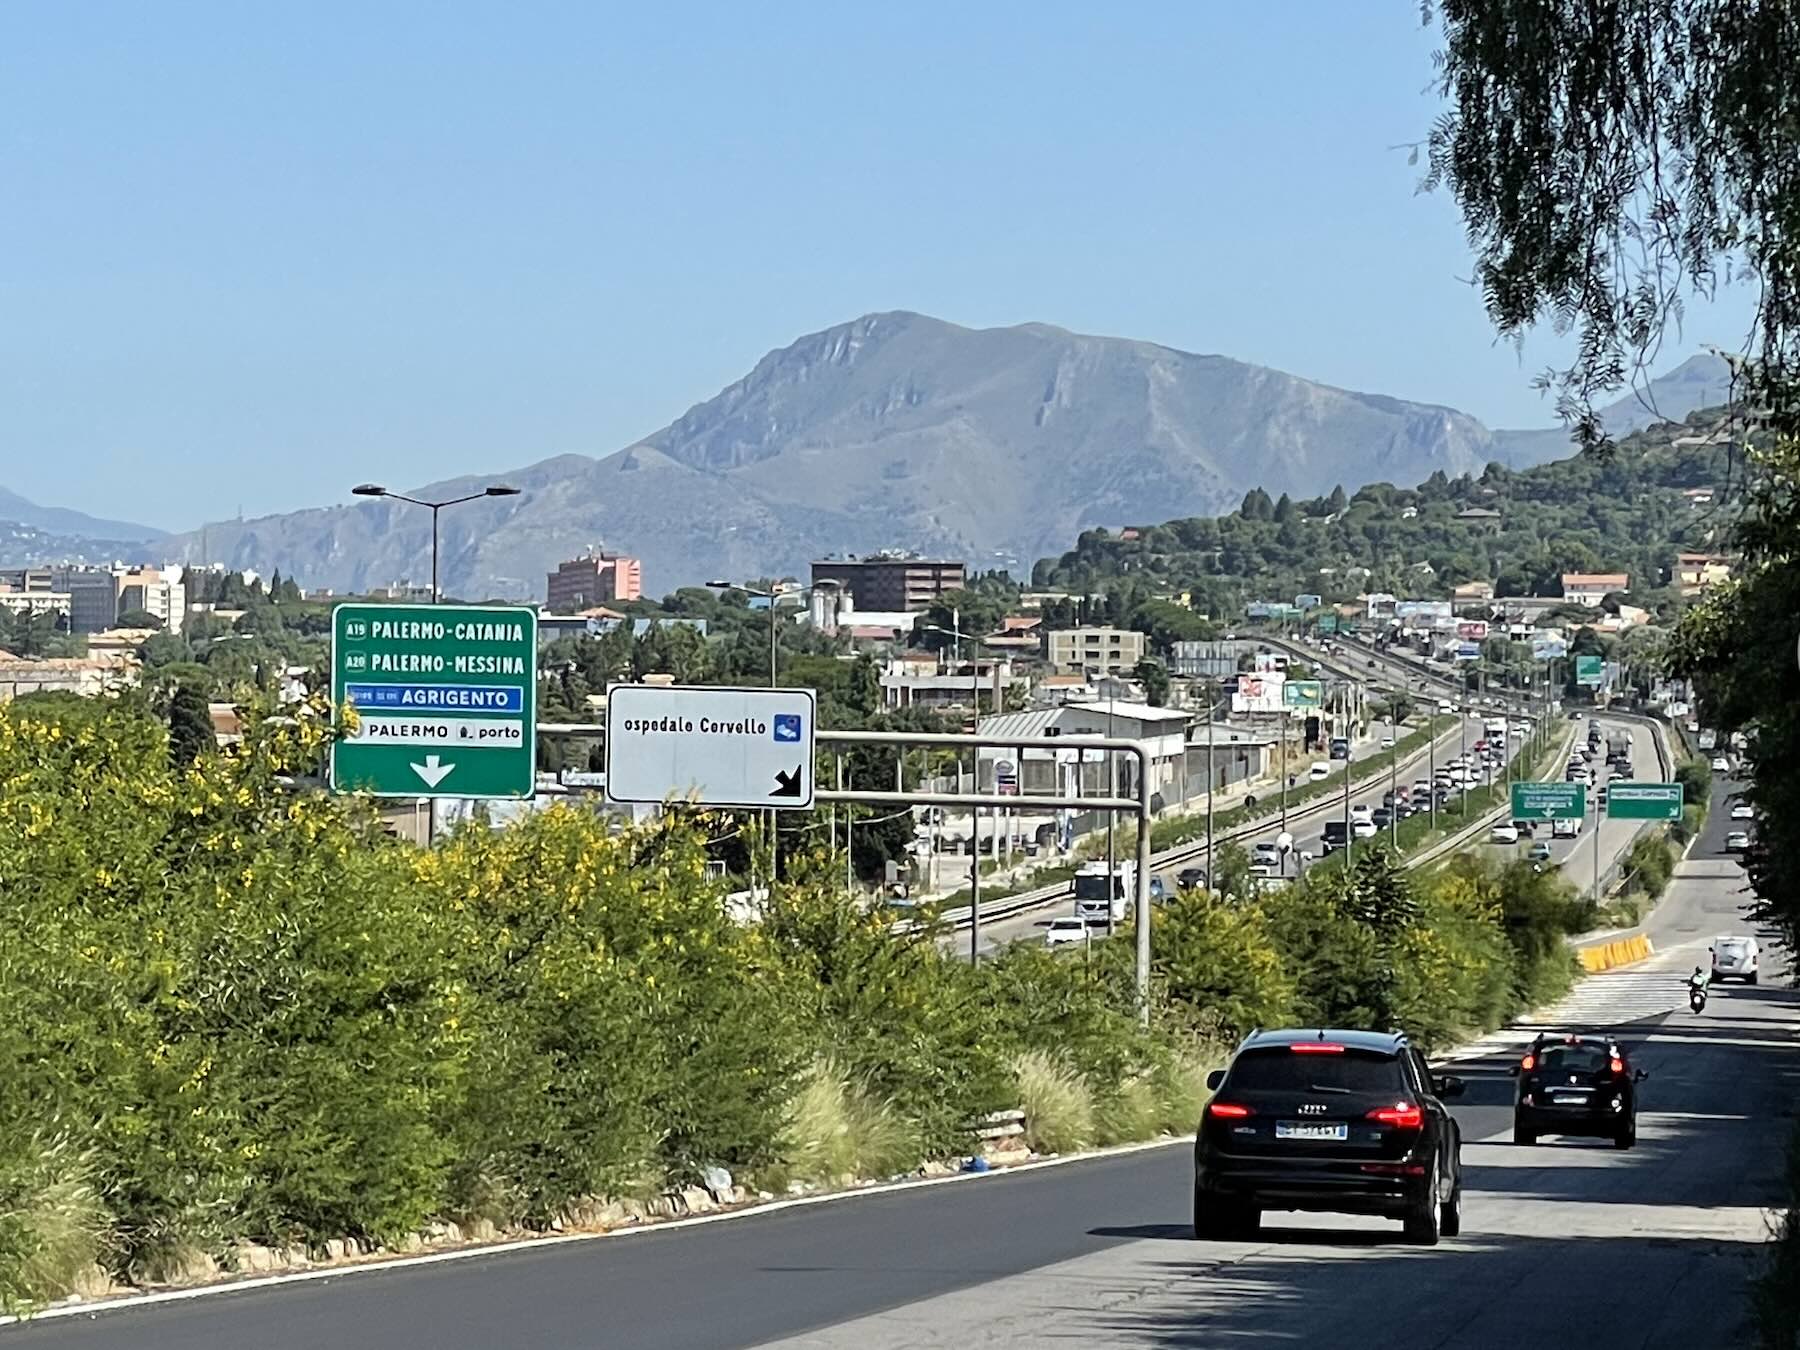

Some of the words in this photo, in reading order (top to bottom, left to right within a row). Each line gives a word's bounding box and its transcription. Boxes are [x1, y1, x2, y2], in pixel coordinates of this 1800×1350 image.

[346, 623, 366, 636] A19
[346, 656, 366, 668] A20
[401, 690, 509, 706] AGRIGENTO
[369, 725, 448, 738] PALERMO
[479, 727, 520, 739] porto
